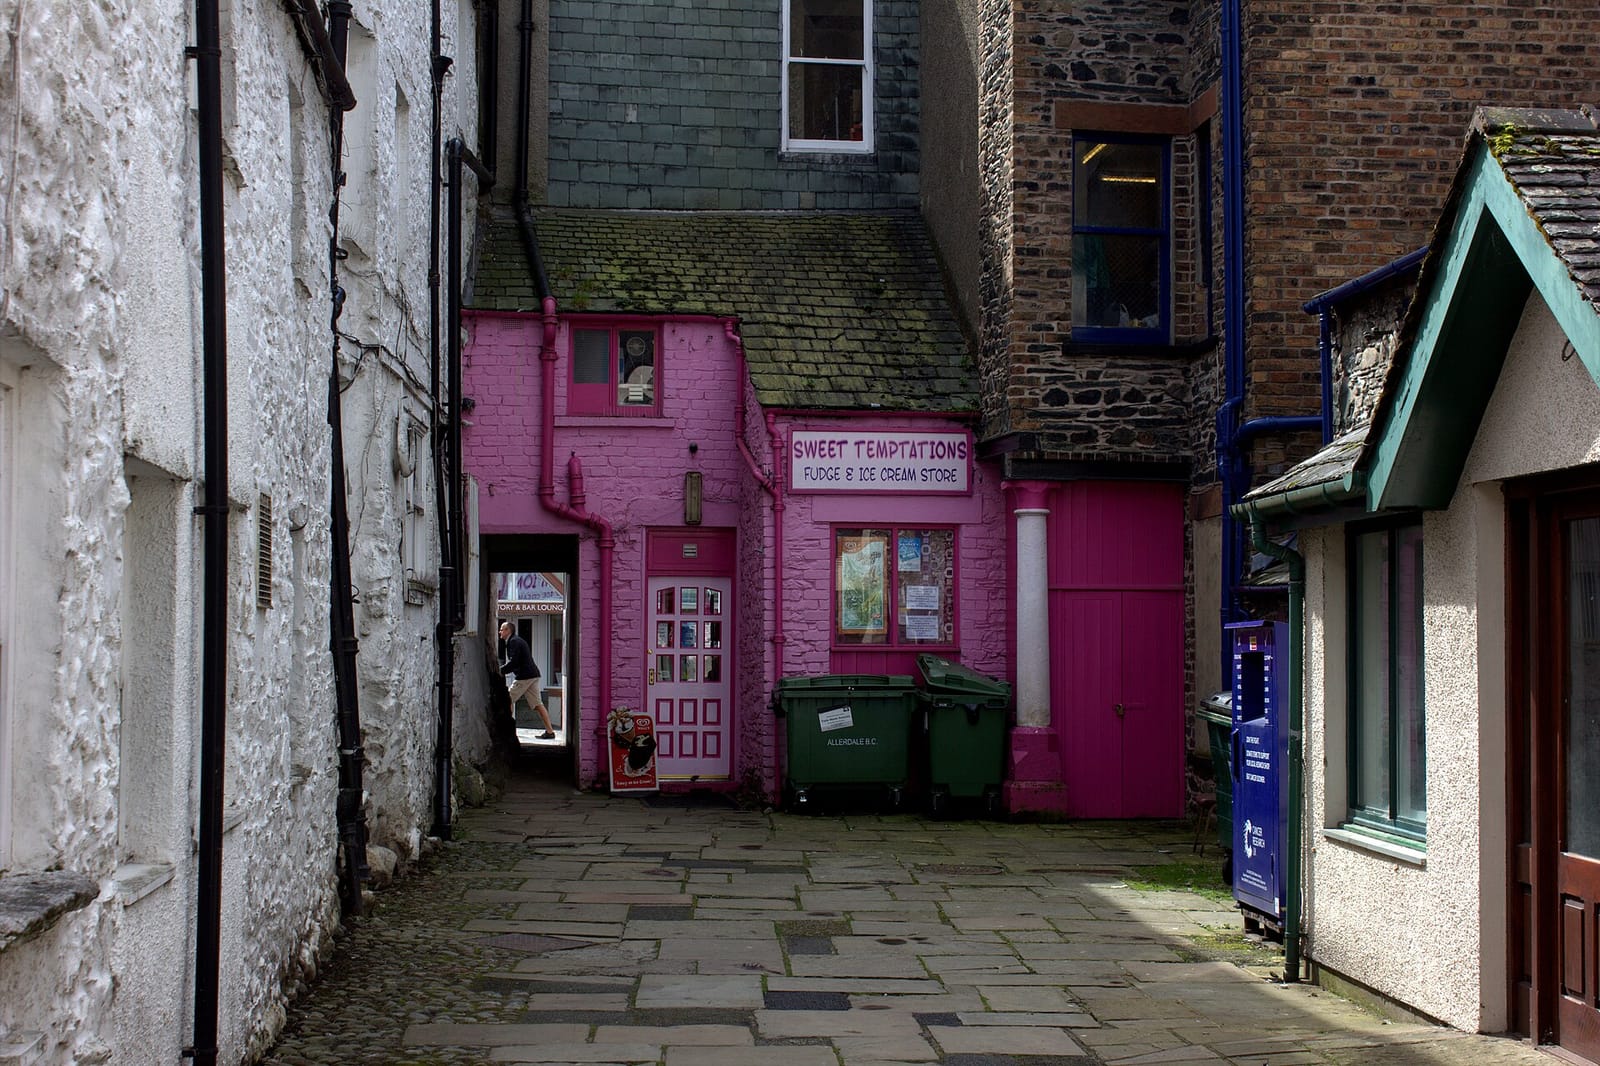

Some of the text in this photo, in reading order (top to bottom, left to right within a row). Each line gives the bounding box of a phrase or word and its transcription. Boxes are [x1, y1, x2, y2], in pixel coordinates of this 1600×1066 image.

[793, 440, 967, 460] SWEET TEMPTATIONS
[804, 466, 957, 482] FUDGE & ICE CREAM STORE
[827, 738, 864, 746] ALLERDALE
